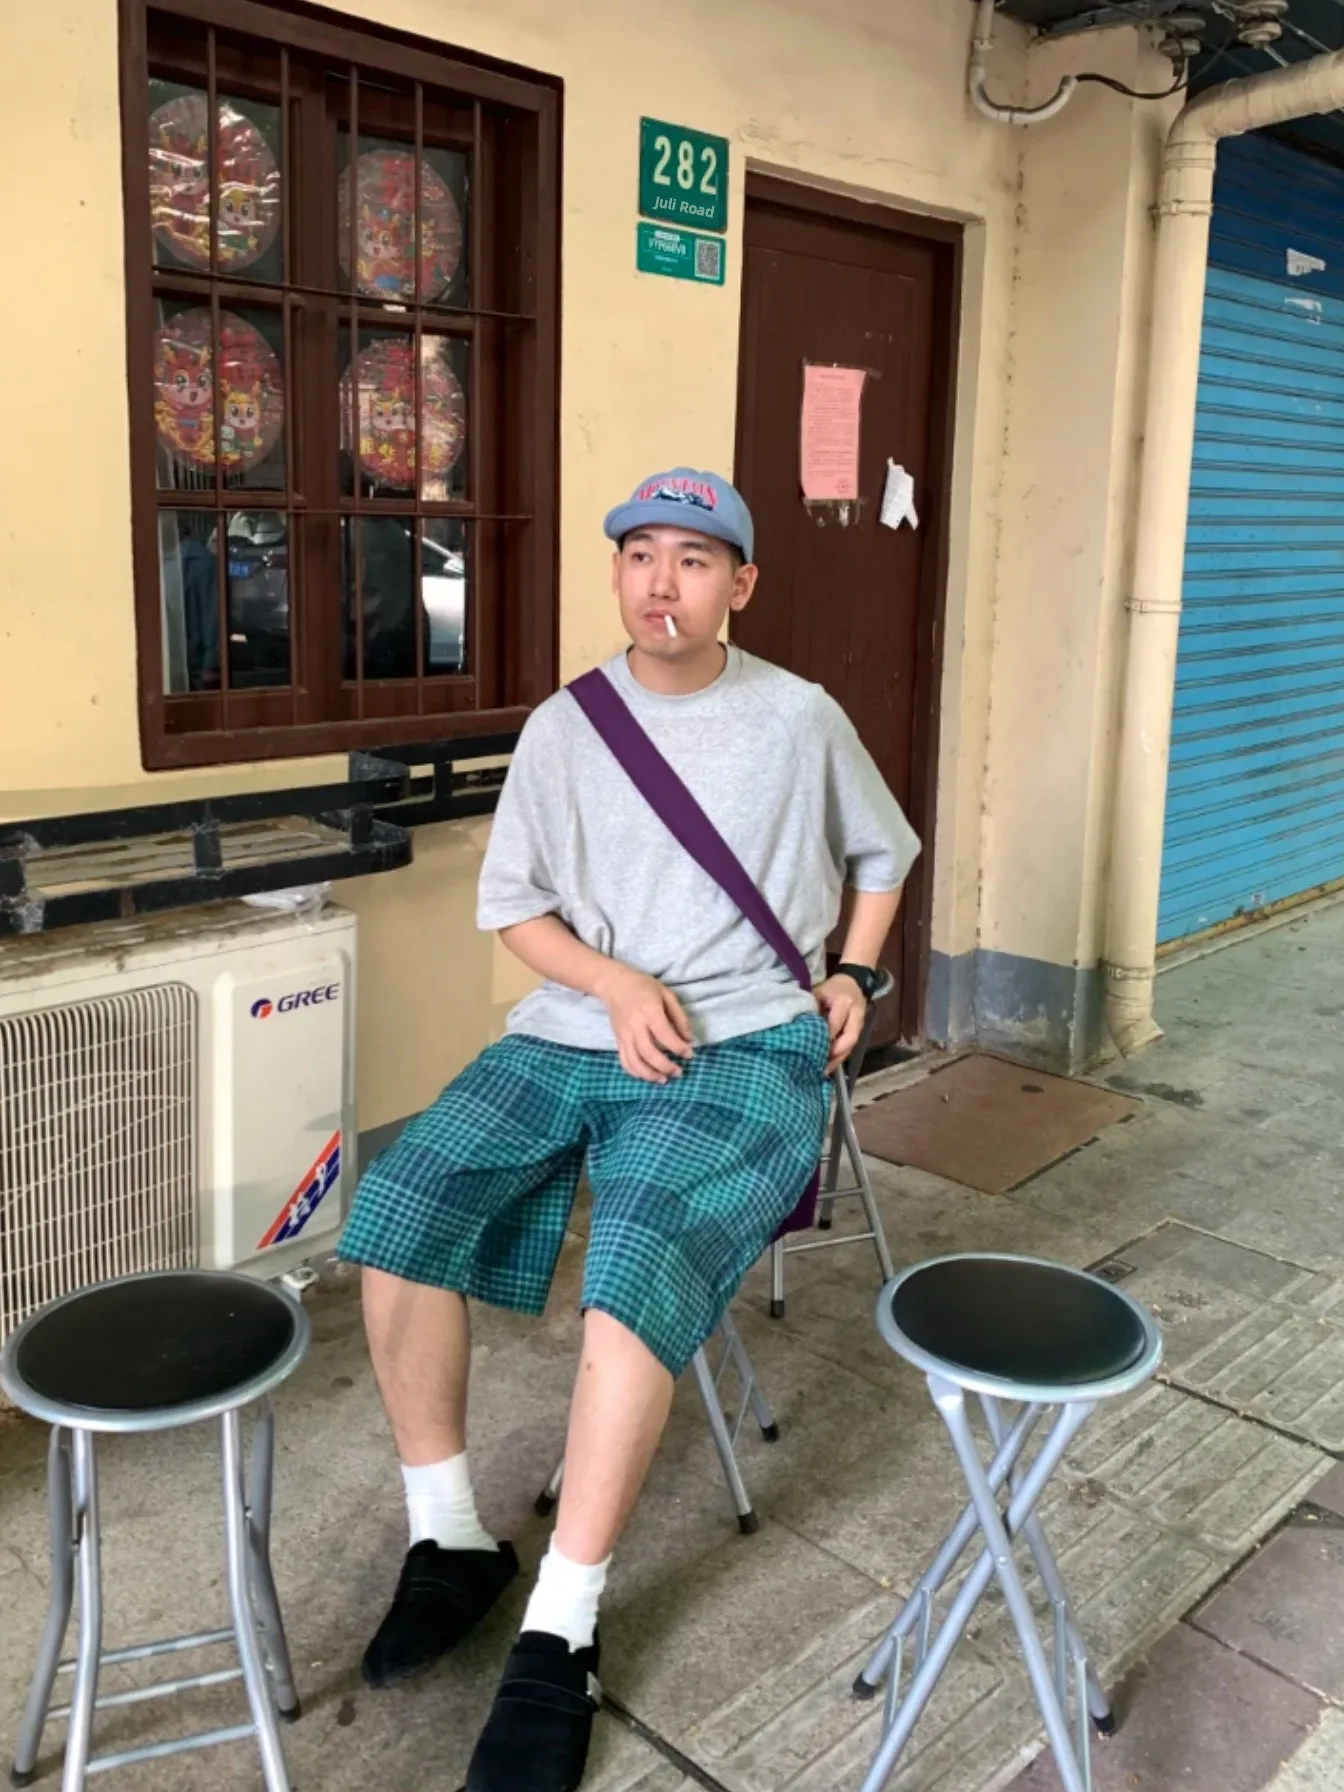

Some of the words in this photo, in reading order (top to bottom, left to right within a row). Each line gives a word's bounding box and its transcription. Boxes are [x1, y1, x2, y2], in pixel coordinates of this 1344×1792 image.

[653, 135, 717, 196] 282
[652, 196, 677, 210] Juli
[680, 200, 715, 218] Road
[277, 982, 340, 1013] GREE
